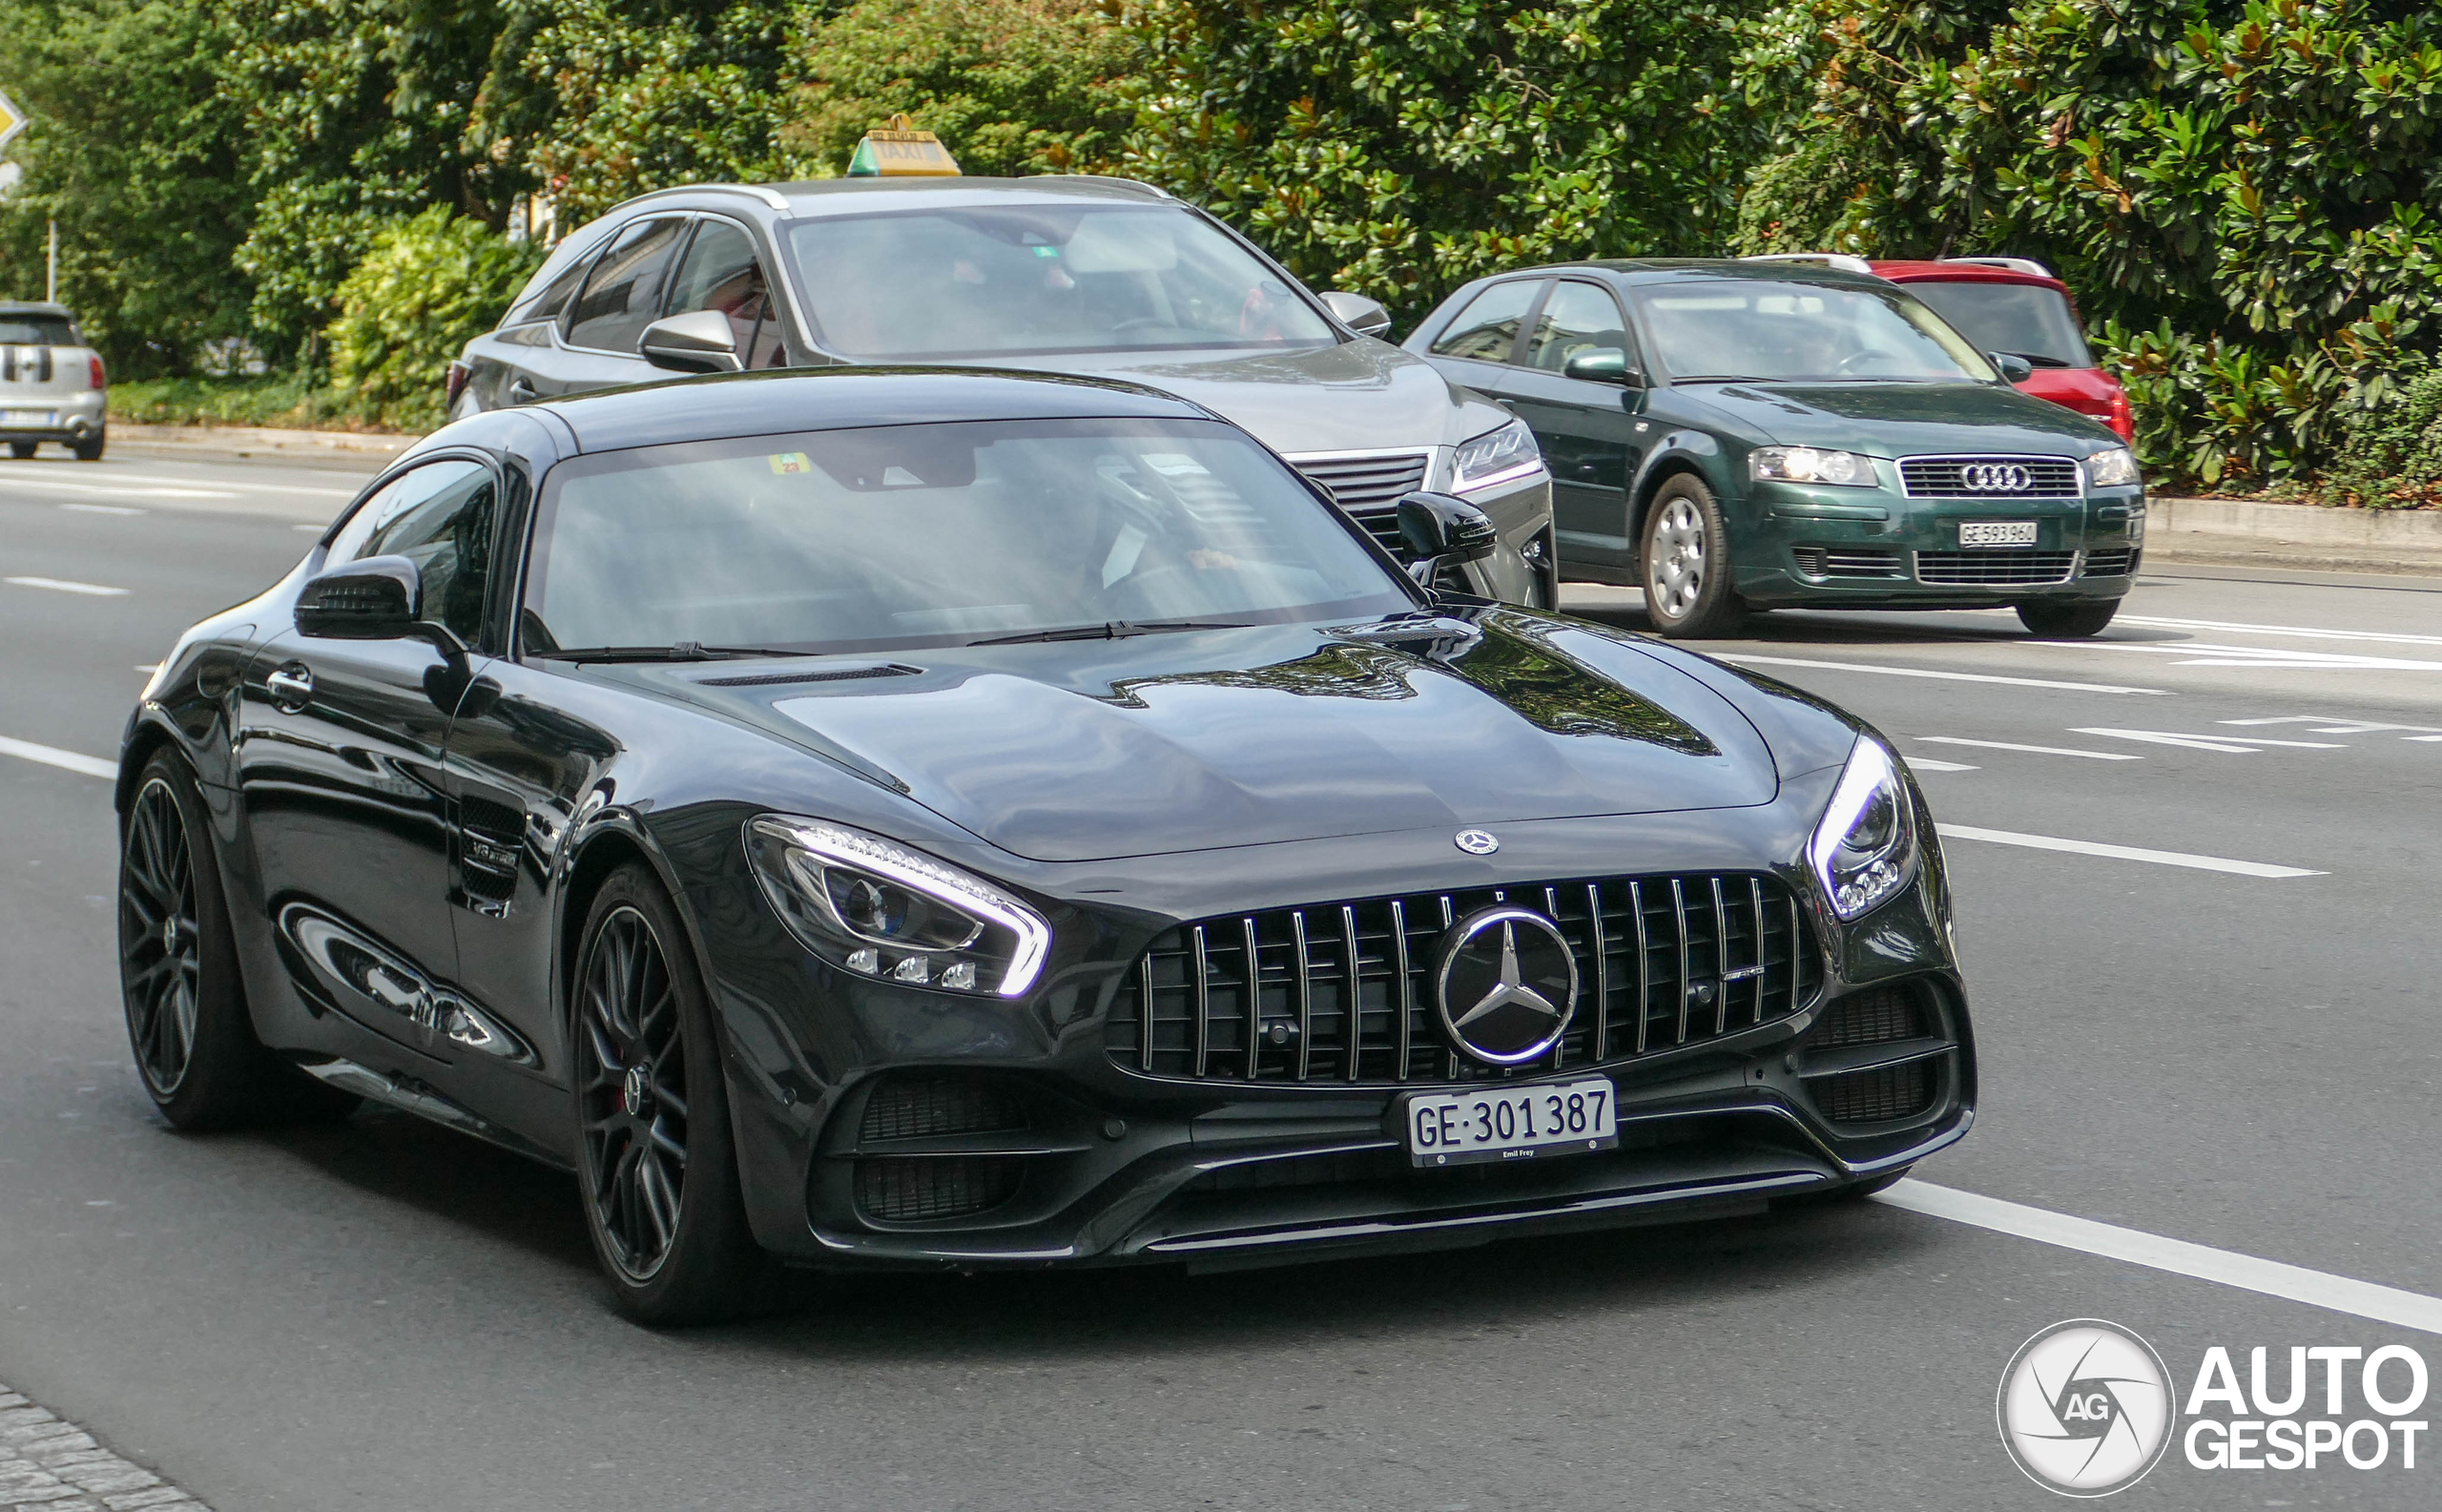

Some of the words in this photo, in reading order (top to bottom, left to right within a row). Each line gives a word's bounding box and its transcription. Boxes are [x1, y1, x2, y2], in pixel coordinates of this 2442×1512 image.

[877, 142, 922, 159] TAXI
[782, 462, 800, 473] 23
[1502, 1150, 1519, 1158] Emil
